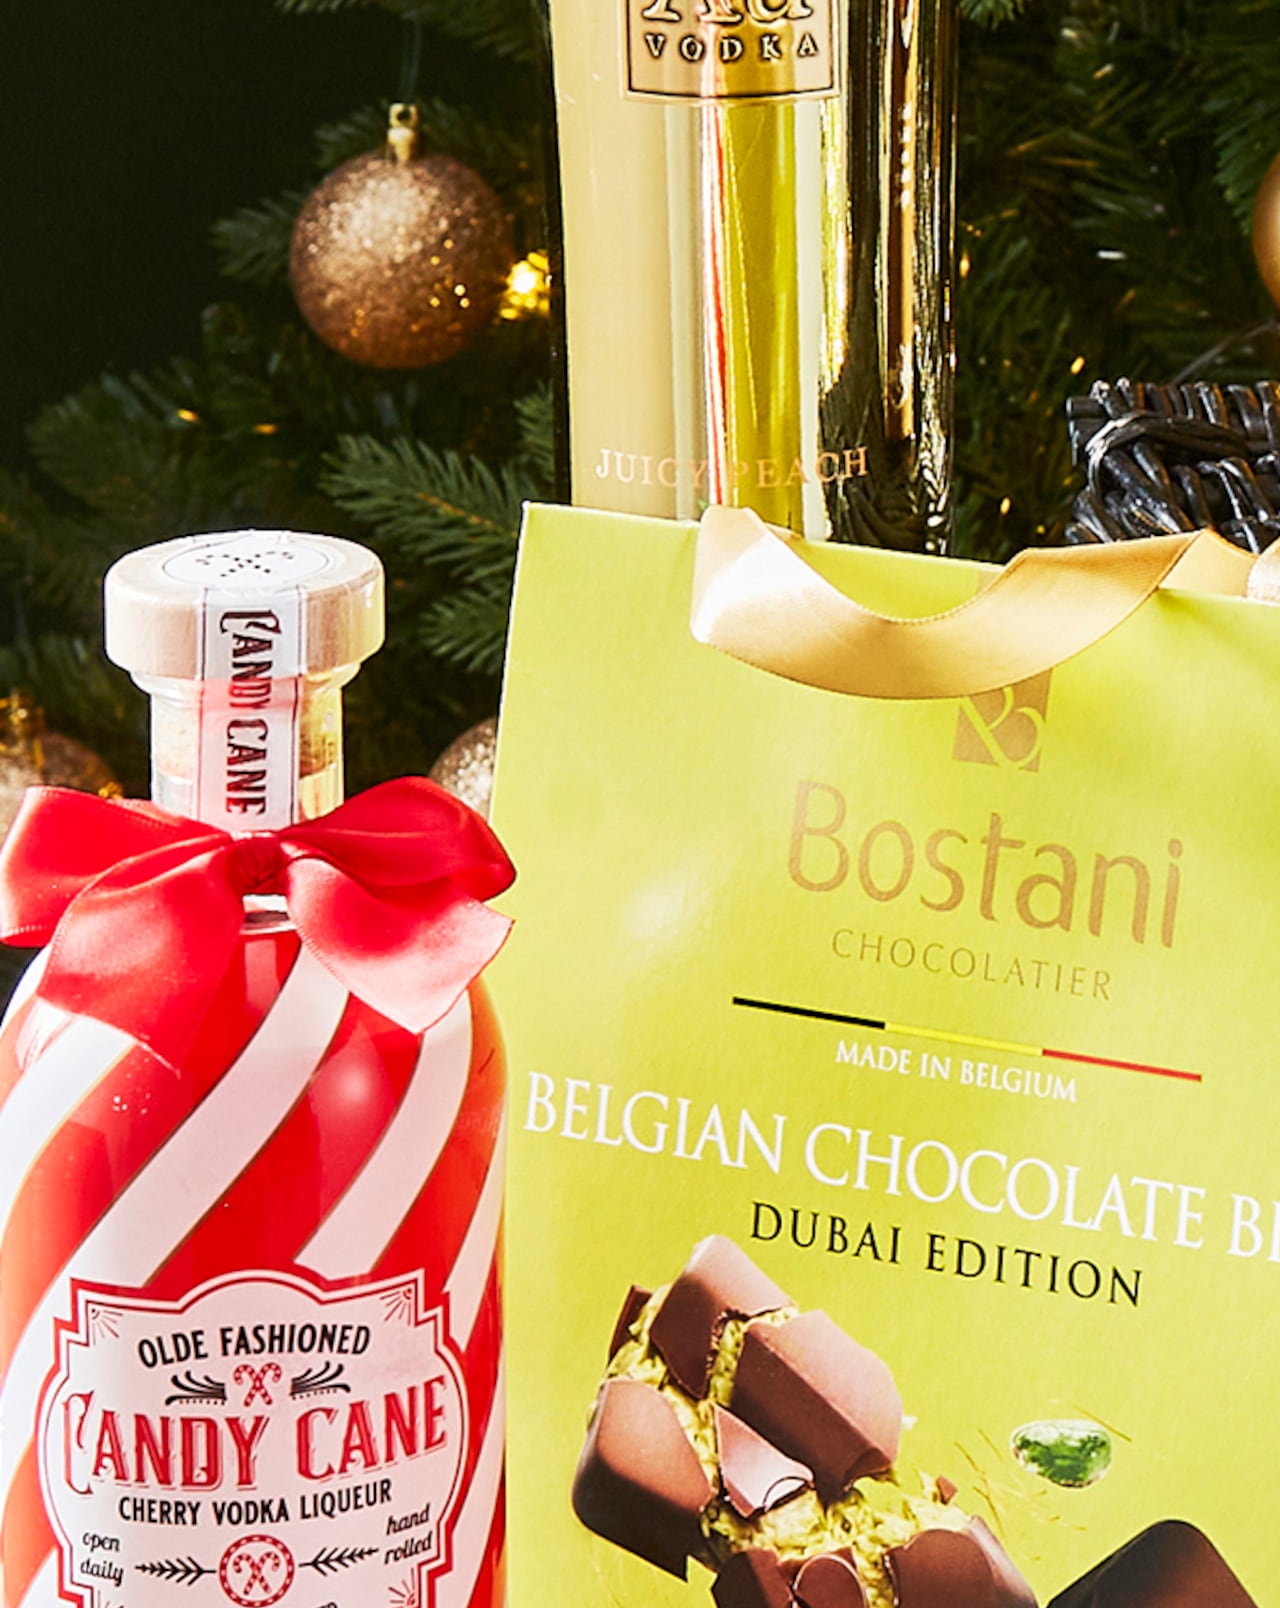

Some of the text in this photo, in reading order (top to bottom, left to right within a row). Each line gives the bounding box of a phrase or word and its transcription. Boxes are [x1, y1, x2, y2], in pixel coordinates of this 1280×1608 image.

[644, 32, 819, 63] VODKA
[595, 446, 870, 489] JUICY PEACH
[219, 608, 282, 816] CANDY CANE
[787, 778, 1184, 949] Bostani
[831, 928, 1112, 1002] CHOCOLATIER
[834, 1040, 1078, 1104] MADE IN BELGIUM
[522, 1070, 788, 1176] BELGIAN
[804, 1122, 1207, 1250] CHOCOLATE
[750, 1201, 1144, 1308] DUBAI EDITION
[138, 1323, 372, 1368] OLDE FASHIONED
[62, 1374, 449, 1496] CANDY CANE
[82, 1503, 432, 1553] open hand
[118, 1480, 393, 1526] CHERRY VODKA LIQUEUR
[79, 1531, 434, 1587] daily rolled
